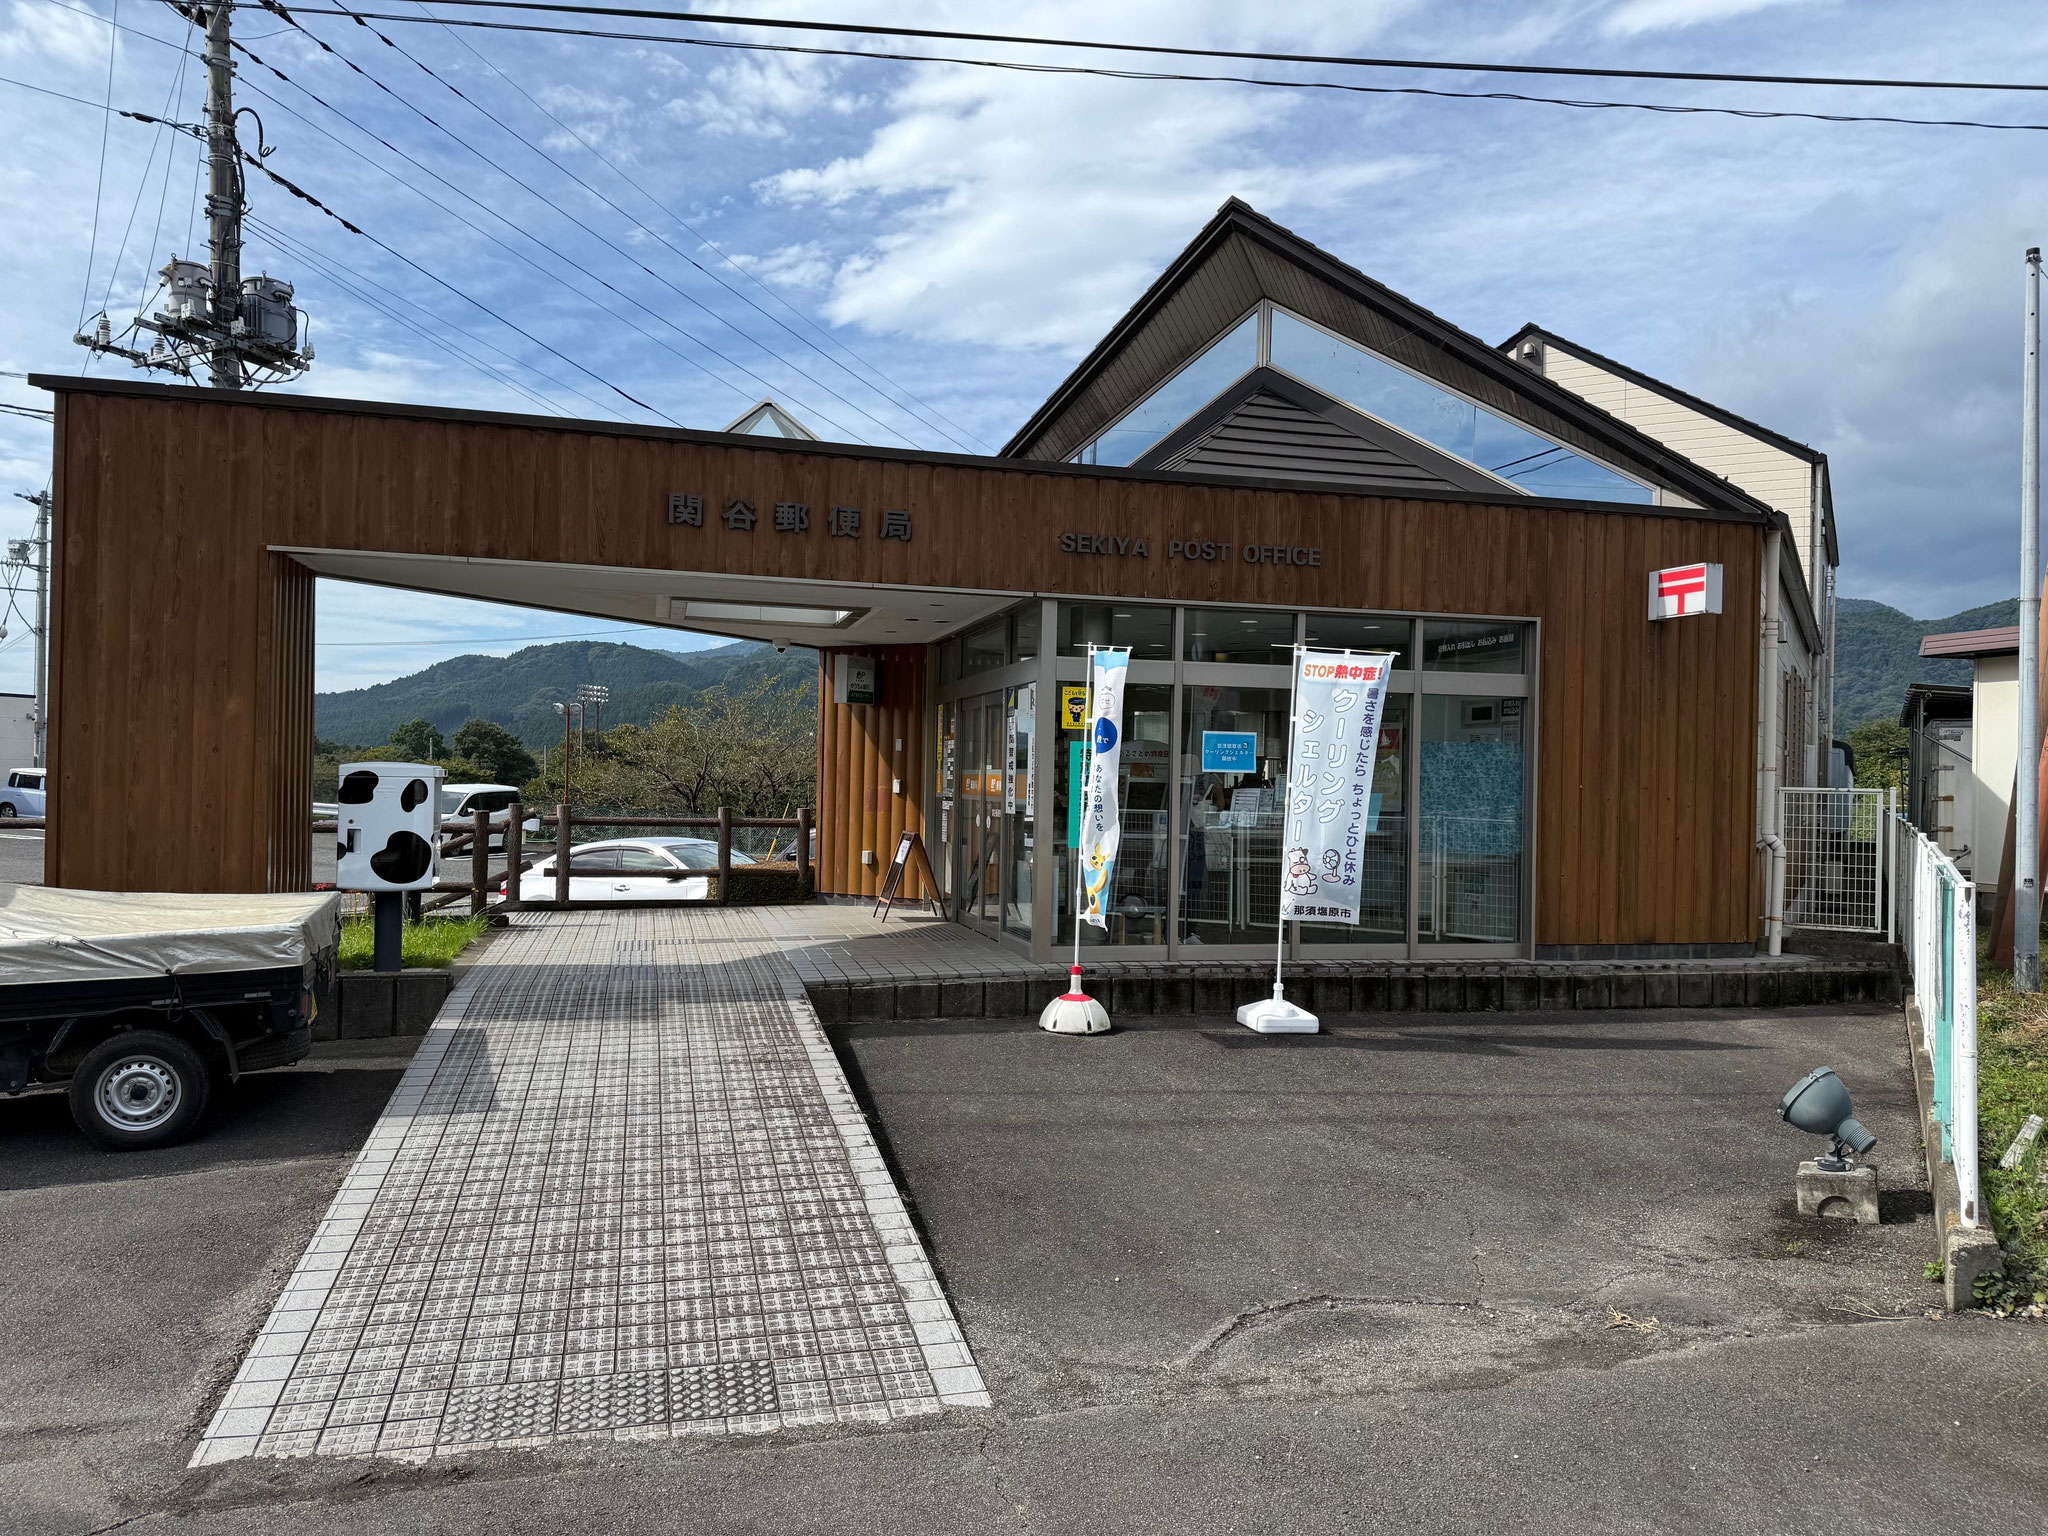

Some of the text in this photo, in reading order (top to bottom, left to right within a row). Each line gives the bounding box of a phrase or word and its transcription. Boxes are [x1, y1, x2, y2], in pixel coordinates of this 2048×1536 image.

[668, 492, 912, 541] 関谷郵便局
[1061, 533, 1321, 567] SEKIYA POST OFFICE
[1304, 664, 1383, 681] STOP熱中症!
[1293, 709, 1325, 842] シェルター
[1317, 689, 1359, 824] クーリング
[1094, 764, 1104, 832] あなたの想いを
[1342, 687, 1380, 887] 暑さを感じたら ちょっとひと休み
[1293, 905, 1352, 919] 那須塩原市
